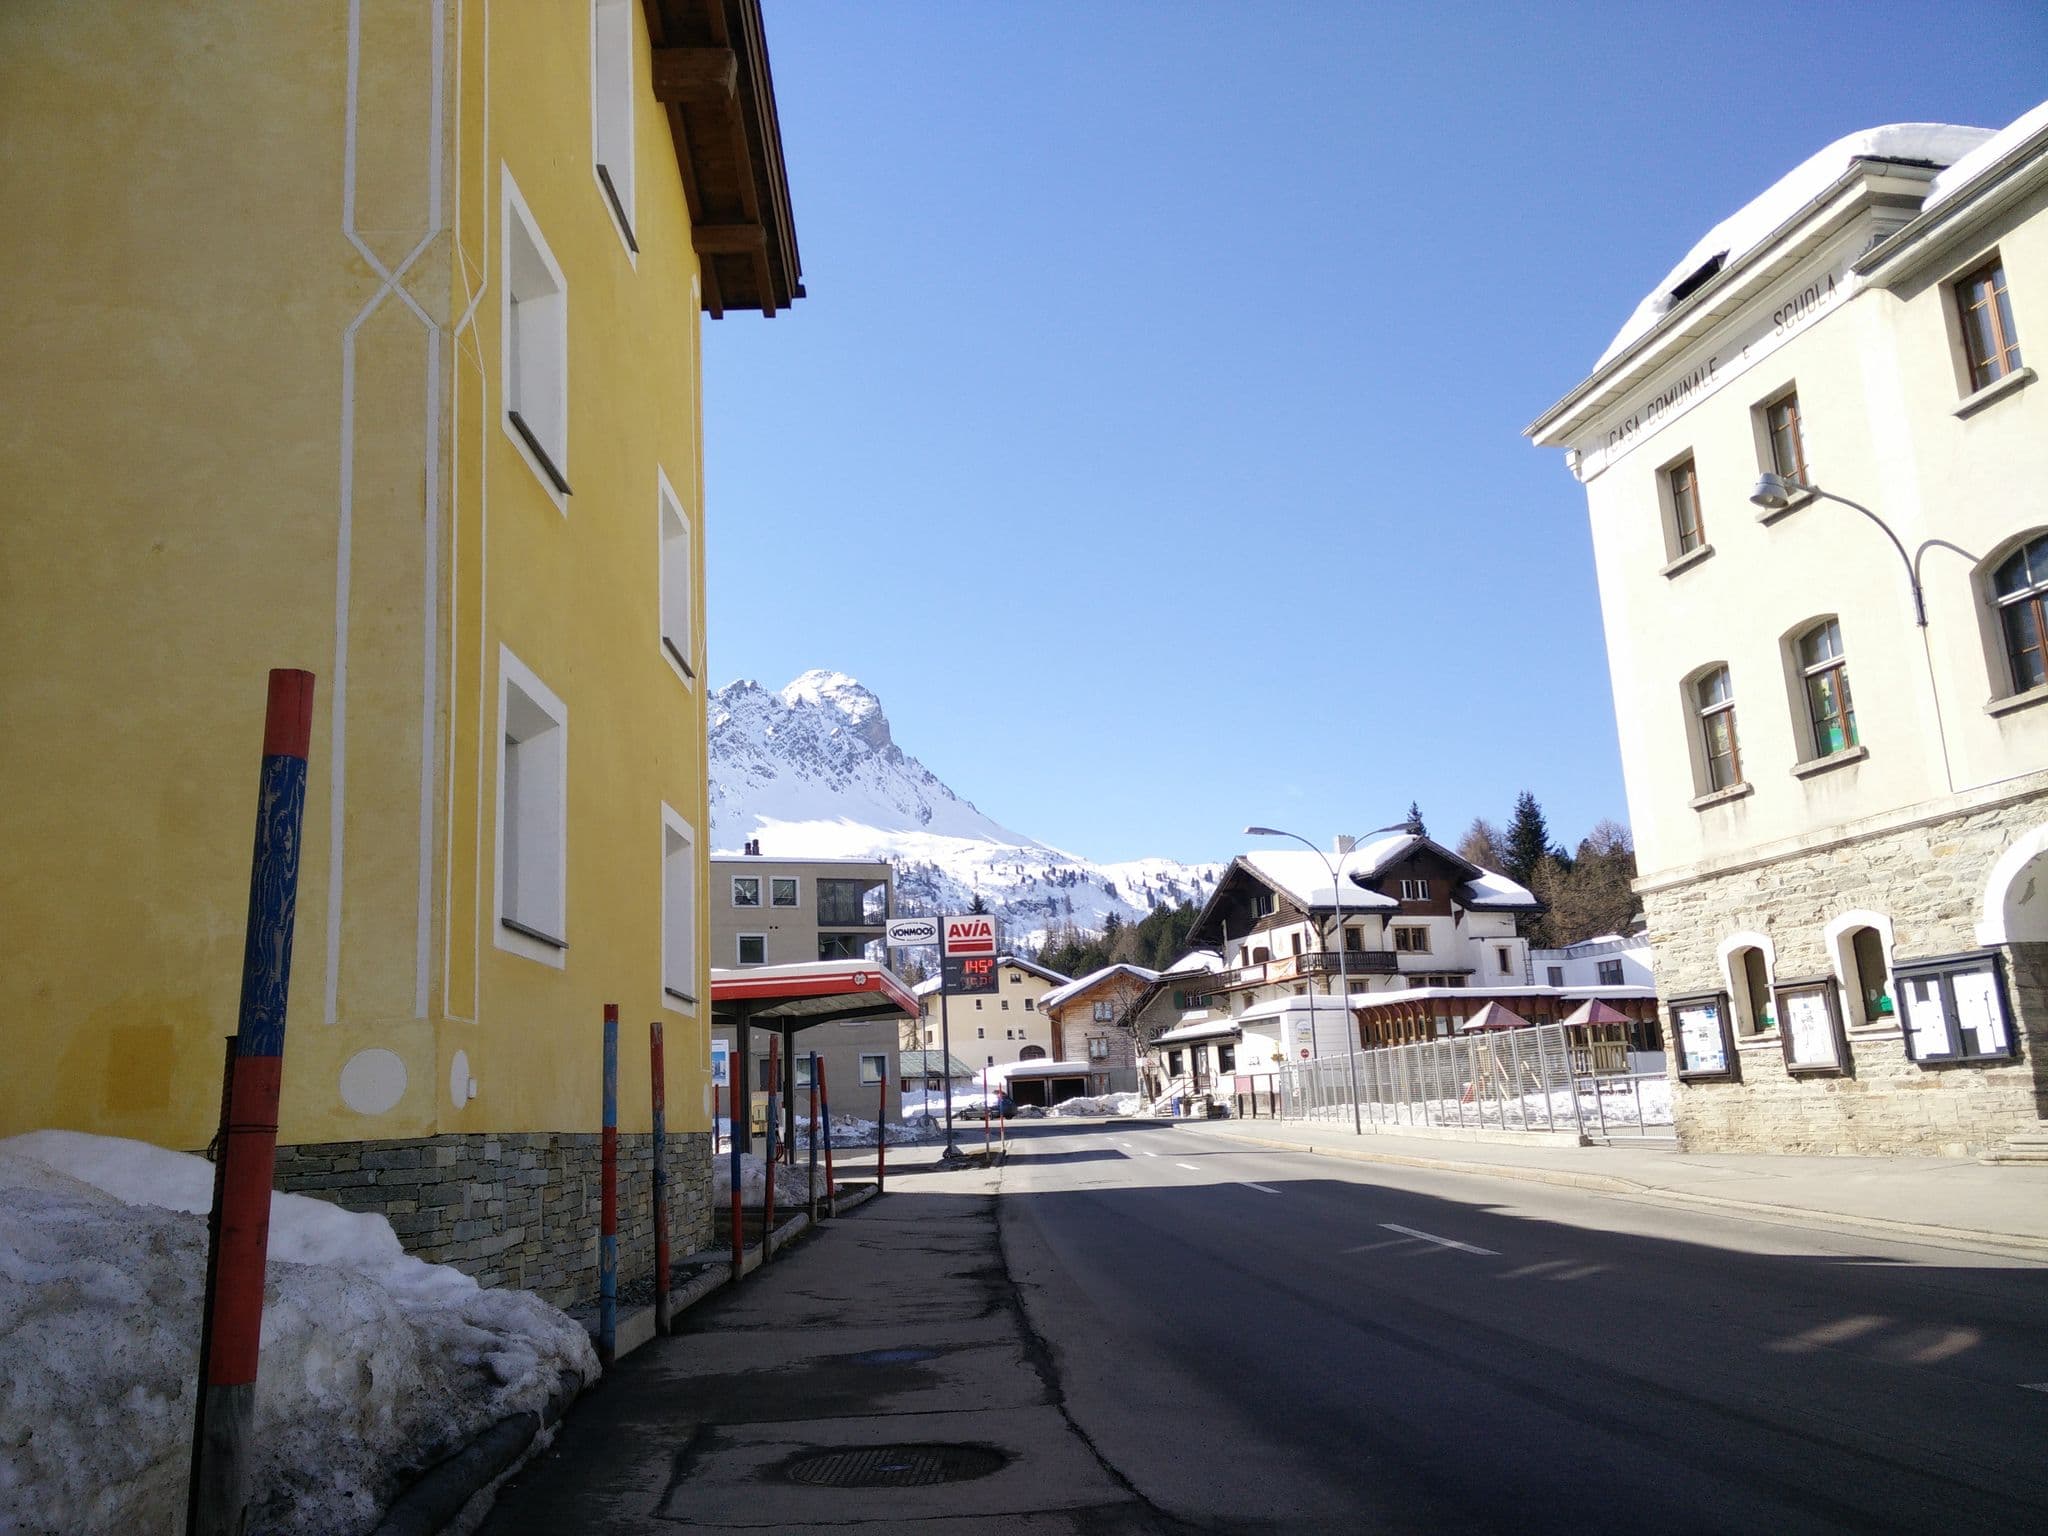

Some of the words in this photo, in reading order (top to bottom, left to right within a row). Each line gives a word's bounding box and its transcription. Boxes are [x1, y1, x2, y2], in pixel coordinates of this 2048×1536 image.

[1609, 415, 1641, 452] CASA
[1647, 357, 1719, 426] COMUNALE
[1773, 273, 1837, 336] SCUOLA
[948, 919, 992, 938] AVIA
